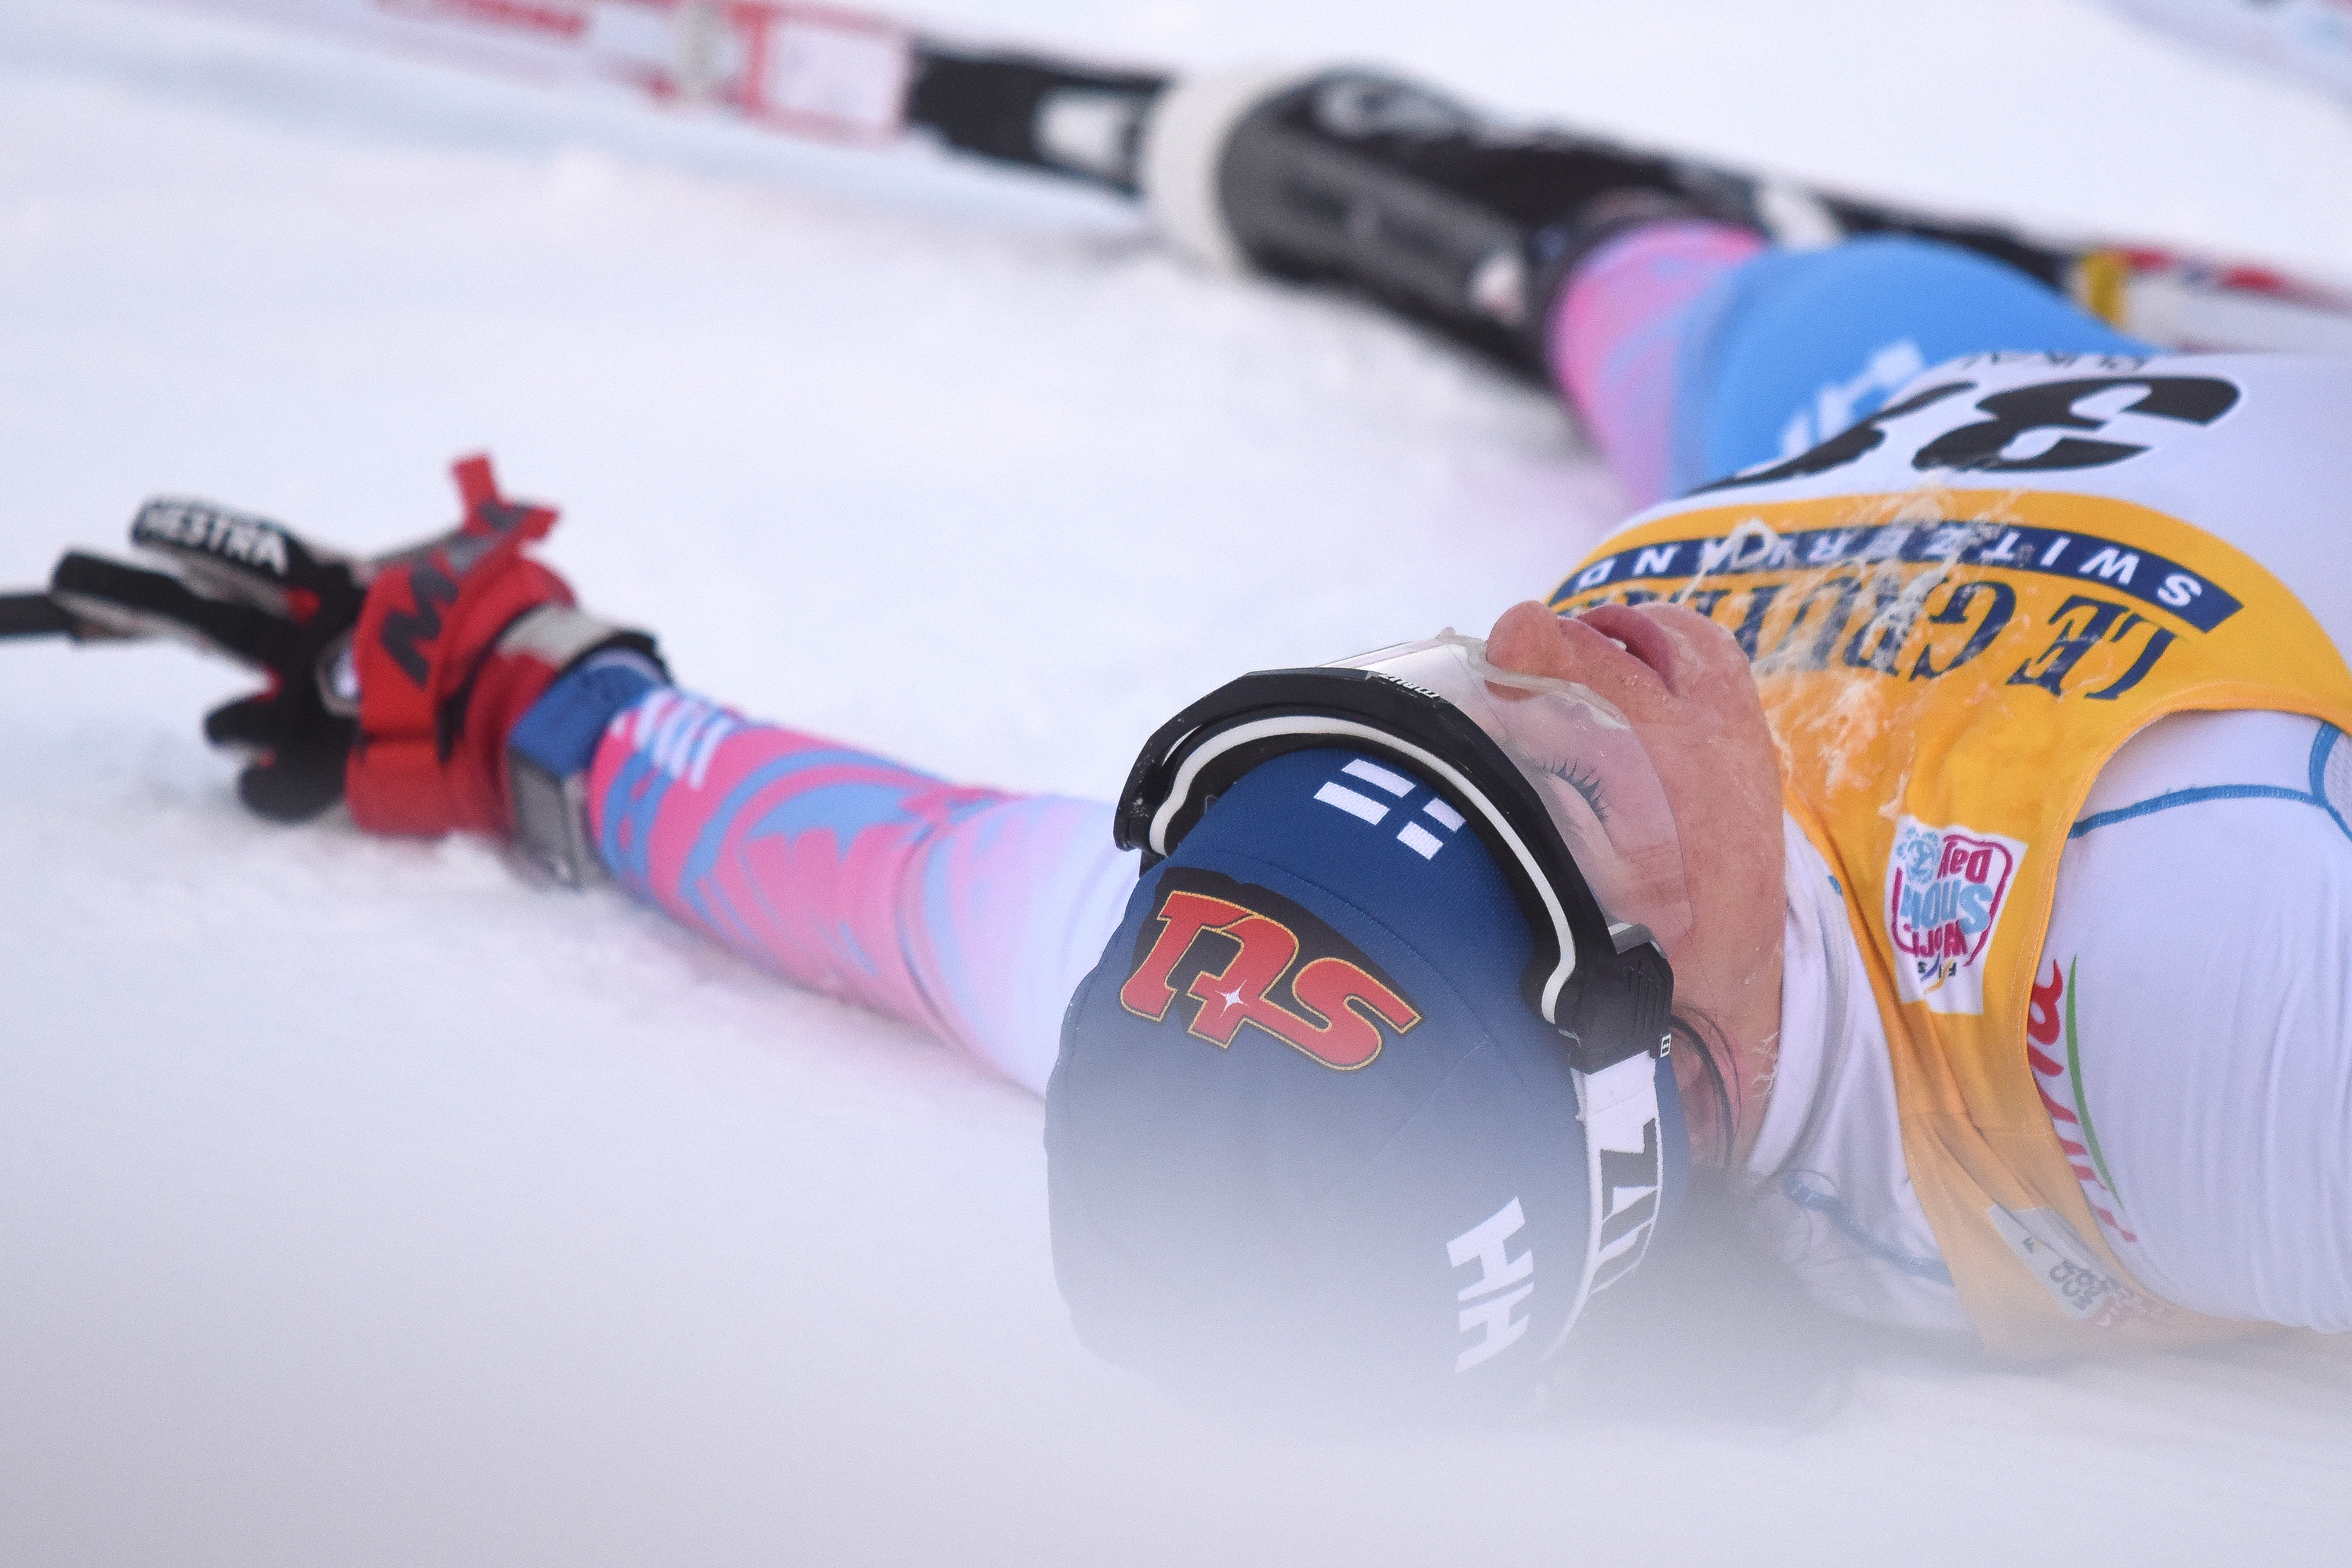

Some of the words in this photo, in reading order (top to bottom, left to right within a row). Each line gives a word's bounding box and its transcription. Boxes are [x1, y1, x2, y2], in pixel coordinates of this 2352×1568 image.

[1577, 522, 2203, 608] SWITZRLAND
[1557, 575, 2016, 682] GRUY
[2005, 593, 2177, 701] LE
[1937, 840, 1994, 884] Day
[1900, 879, 1993, 935] Snow
